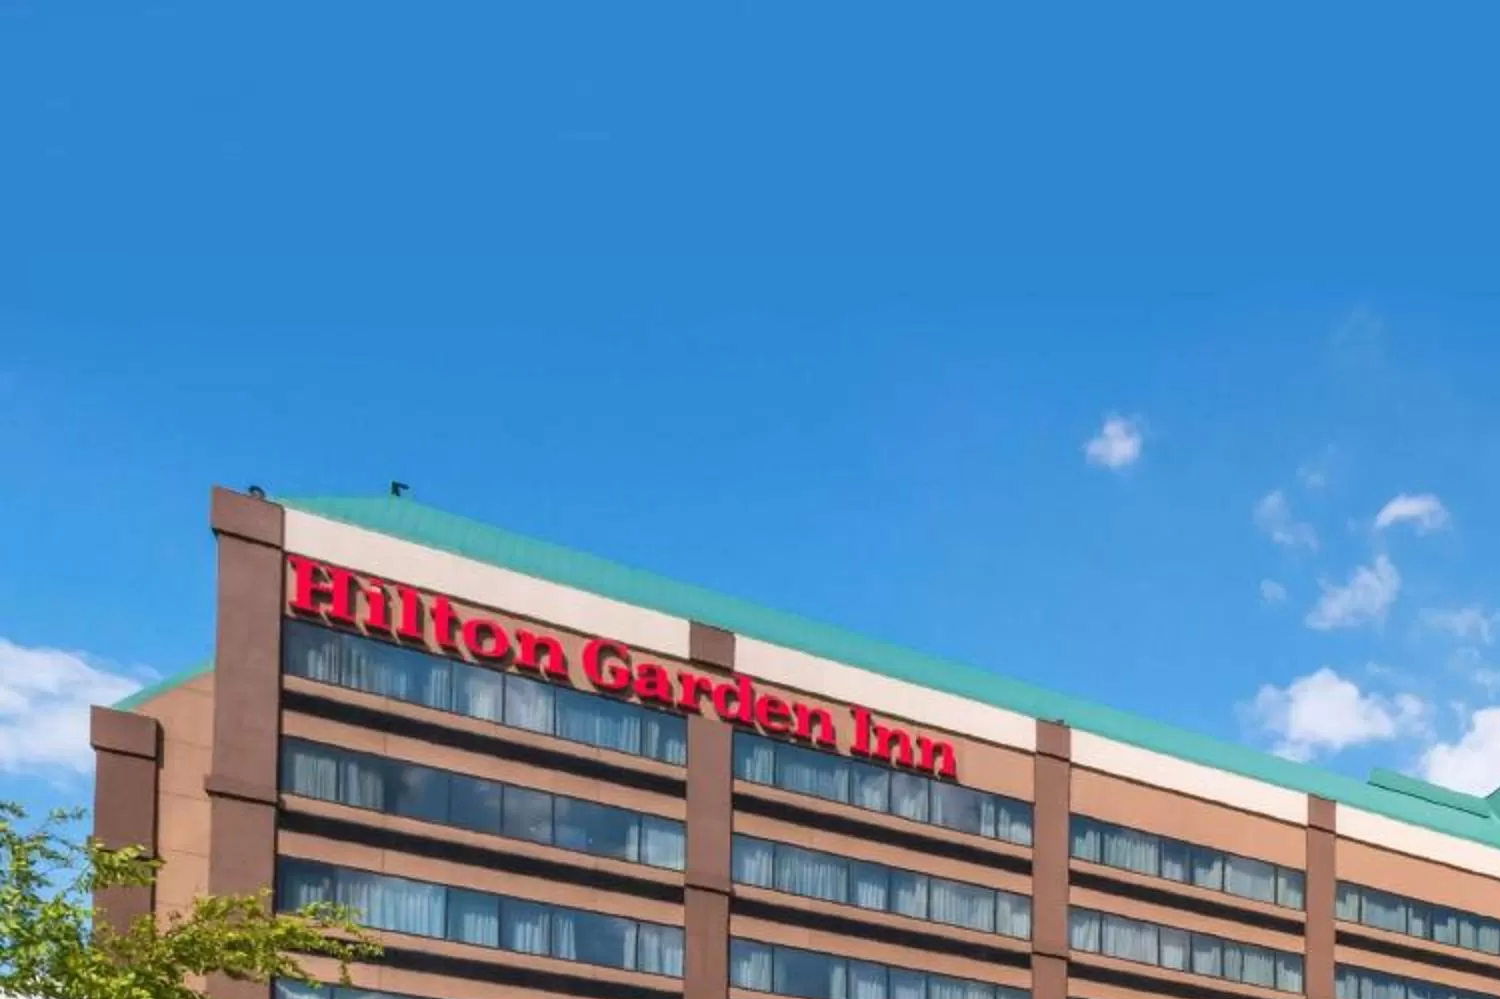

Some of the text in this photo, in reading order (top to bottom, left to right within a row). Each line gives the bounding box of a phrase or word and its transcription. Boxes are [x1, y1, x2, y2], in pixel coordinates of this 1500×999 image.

[286, 553, 958, 778] Hilton Garden Inn
